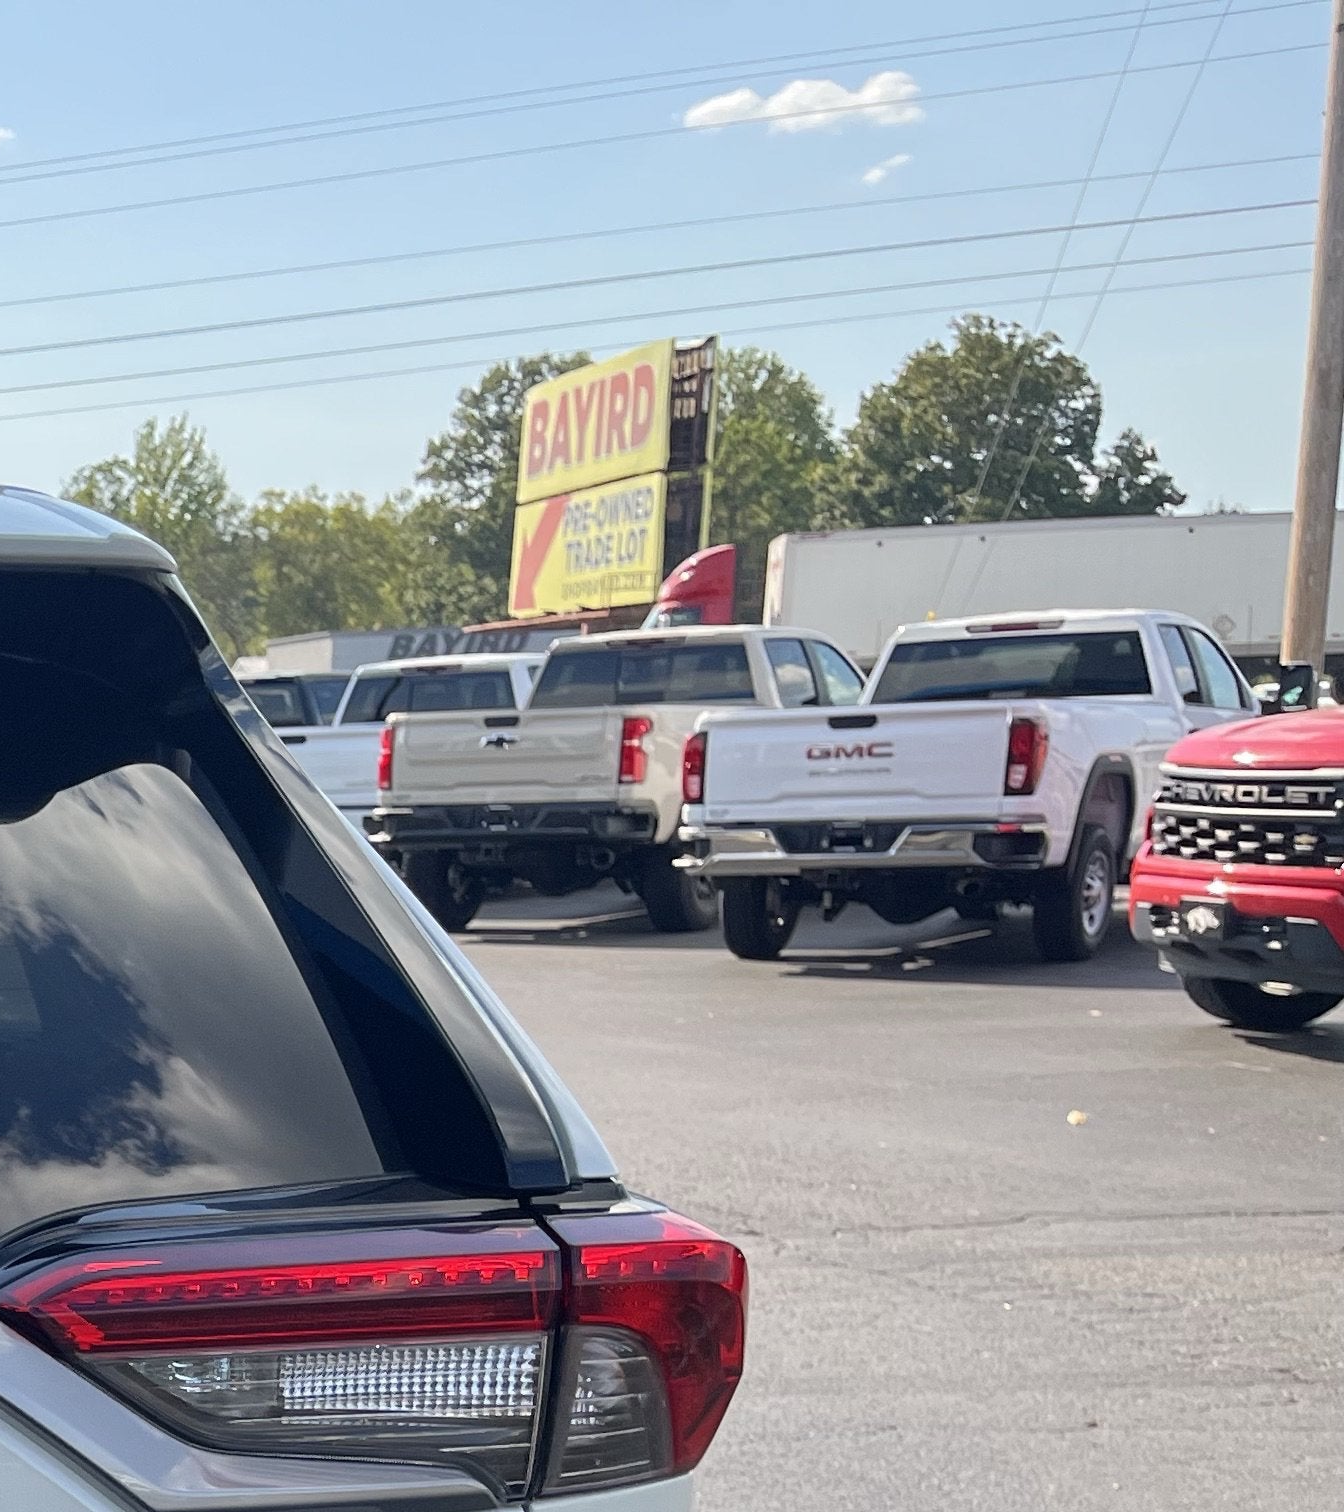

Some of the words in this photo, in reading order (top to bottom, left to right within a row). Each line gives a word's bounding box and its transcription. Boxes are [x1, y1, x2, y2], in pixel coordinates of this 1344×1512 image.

[527, 363, 656, 478] BAYIRD
[563, 486, 653, 536] PRE-OWNED
[566, 534, 613, 574] TRADE
[616, 527, 648, 566] LOT
[806, 742, 894, 760] GMC
[1160, 781, 1336, 805] CHEVROLET
